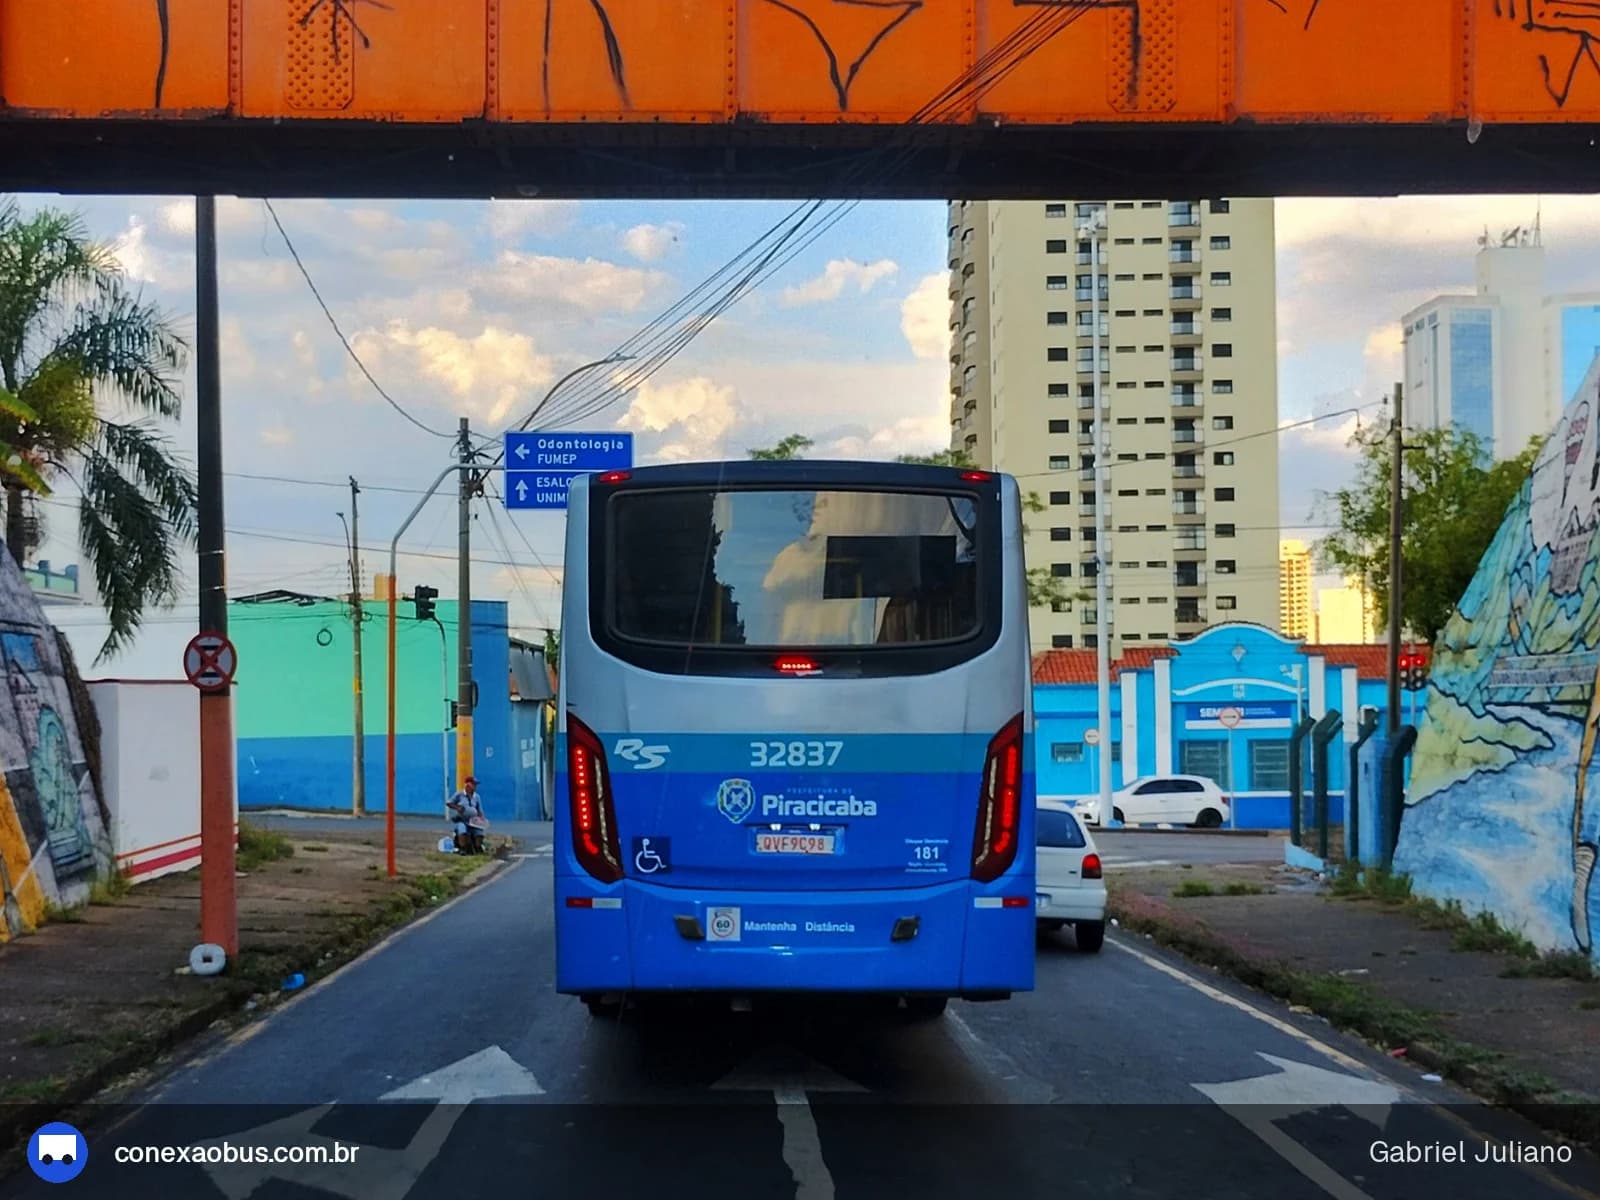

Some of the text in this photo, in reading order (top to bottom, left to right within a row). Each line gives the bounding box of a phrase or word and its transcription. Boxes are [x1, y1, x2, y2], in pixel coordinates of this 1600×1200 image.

[538, 439, 624, 452] Odontologia
[537, 454, 577, 464] FUMEP
[750, 741, 843, 767] 32837
[762, 794, 878, 817] Piracicaba
[763, 836, 825, 851] QVF9C98
[913, 846, 939, 860] 181
[716, 919, 730, 929] 60
[744, 920, 855, 932] Mantenha Distância
